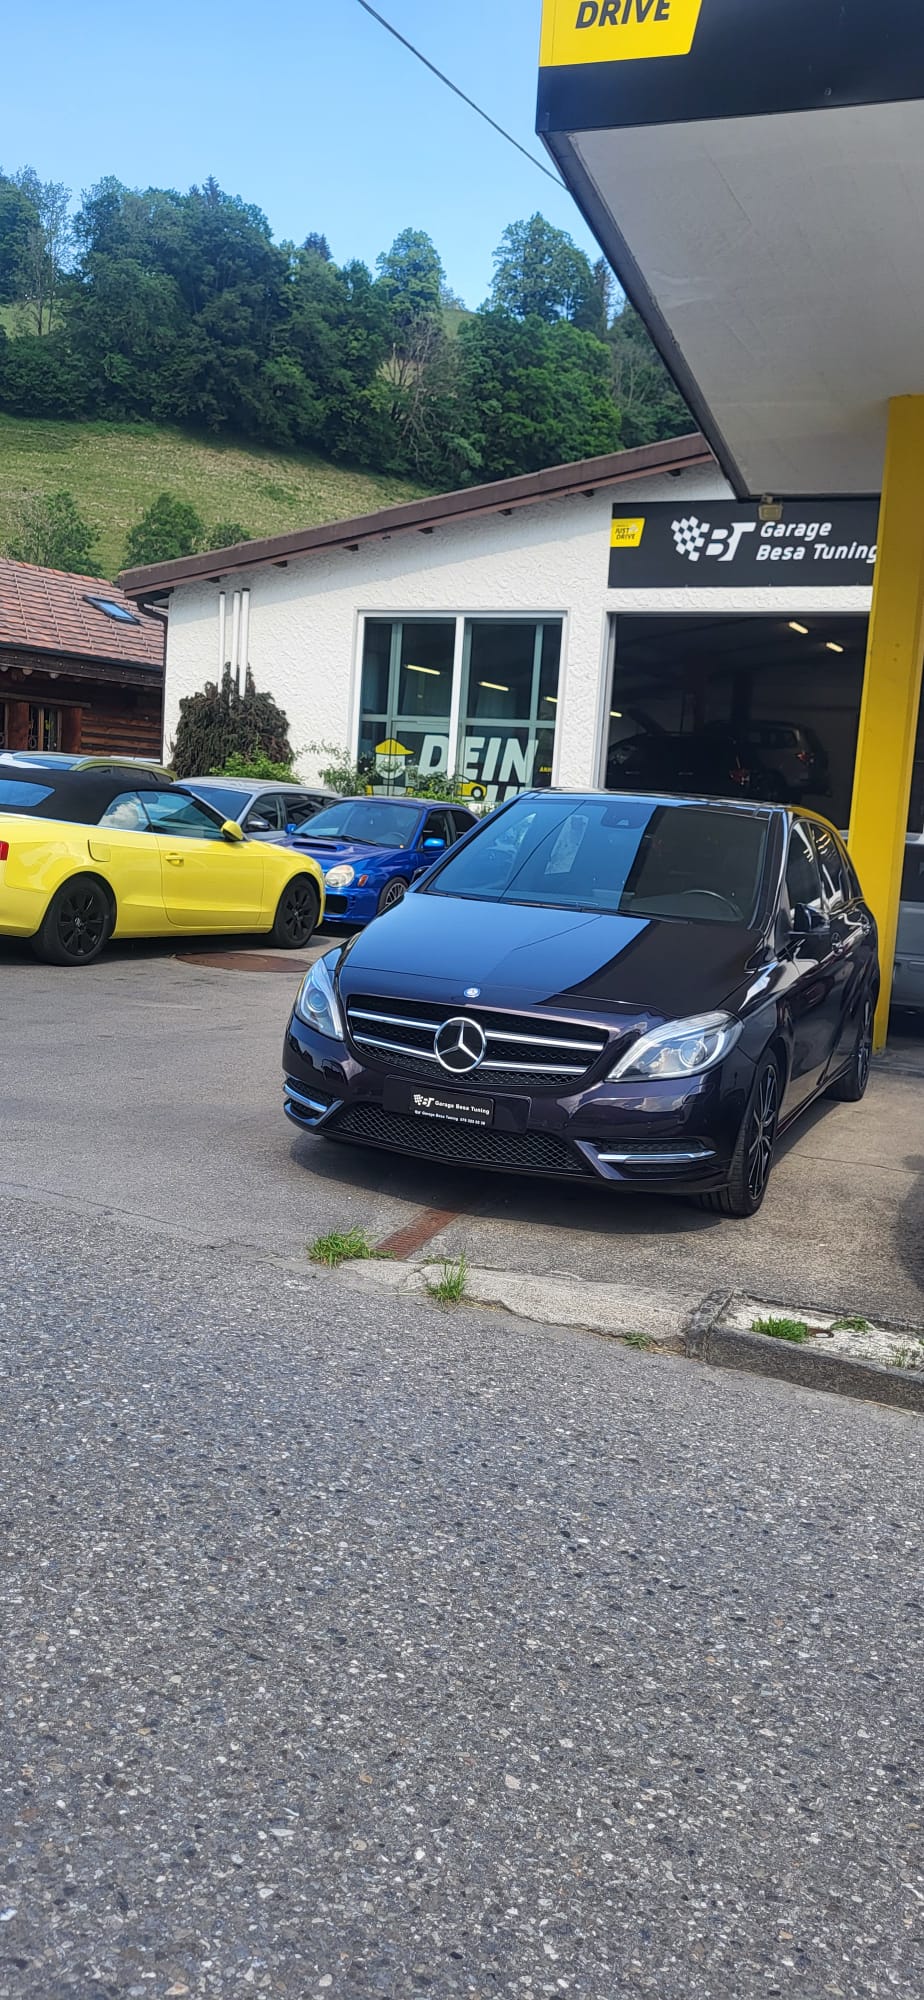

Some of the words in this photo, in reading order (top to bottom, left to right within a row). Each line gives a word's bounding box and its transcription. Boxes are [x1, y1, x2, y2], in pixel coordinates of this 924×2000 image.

[575, 0, 670, 29] DRIVE
[705, 522, 757, 562] BT
[760, 521, 832, 541] Garage
[756, 544, 805, 561] Besa
[813, 541, 878, 564] Tuning
[417, 734, 539, 784] DEIN
[435, 1100, 454, 1109] Garage
[471, 1106, 490, 1115] Tuning
